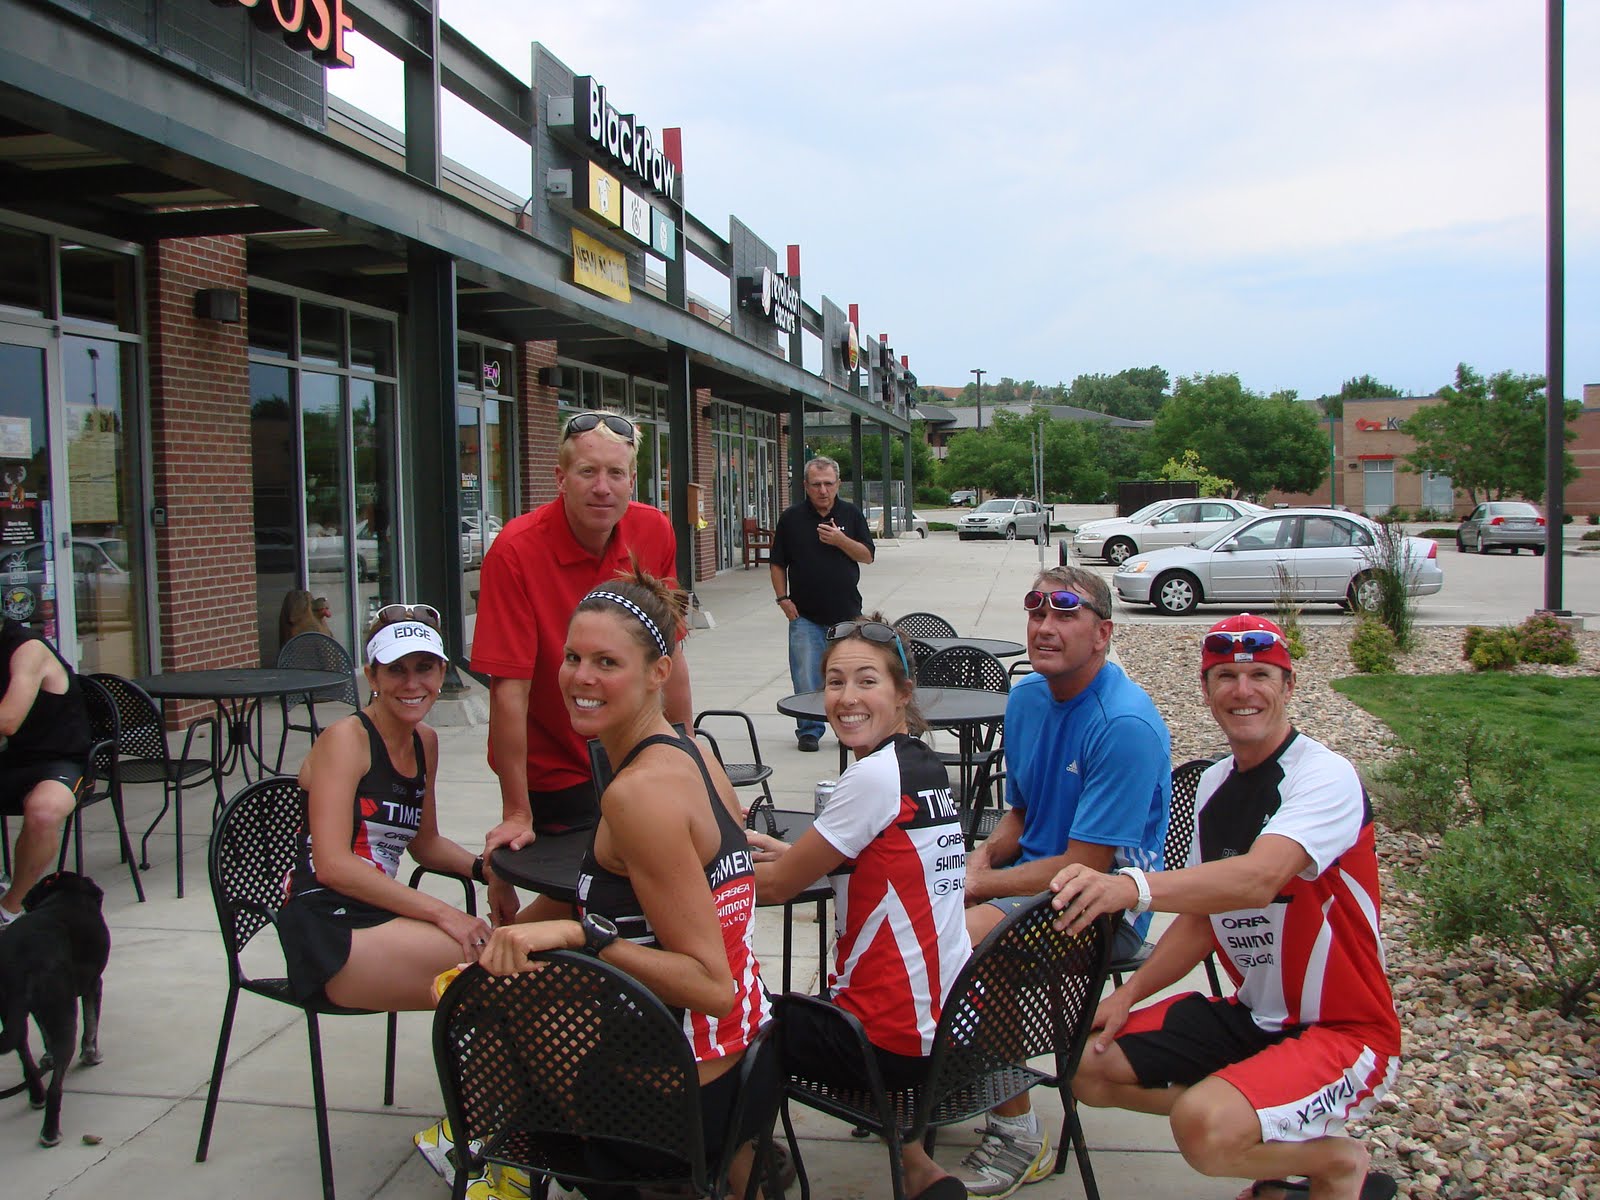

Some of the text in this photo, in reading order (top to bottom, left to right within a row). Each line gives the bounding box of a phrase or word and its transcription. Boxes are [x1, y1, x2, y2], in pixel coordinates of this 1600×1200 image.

[394, 626, 431, 640] EDGE
[383, 801, 422, 826] TIME
[917, 788, 958, 818] TIME
[385, 832, 414, 842] ORBE
[710, 850, 752, 888] TIMEX
[935, 854, 965, 872] SHIMA
[1296, 1074, 1355, 1131] TIMEX
